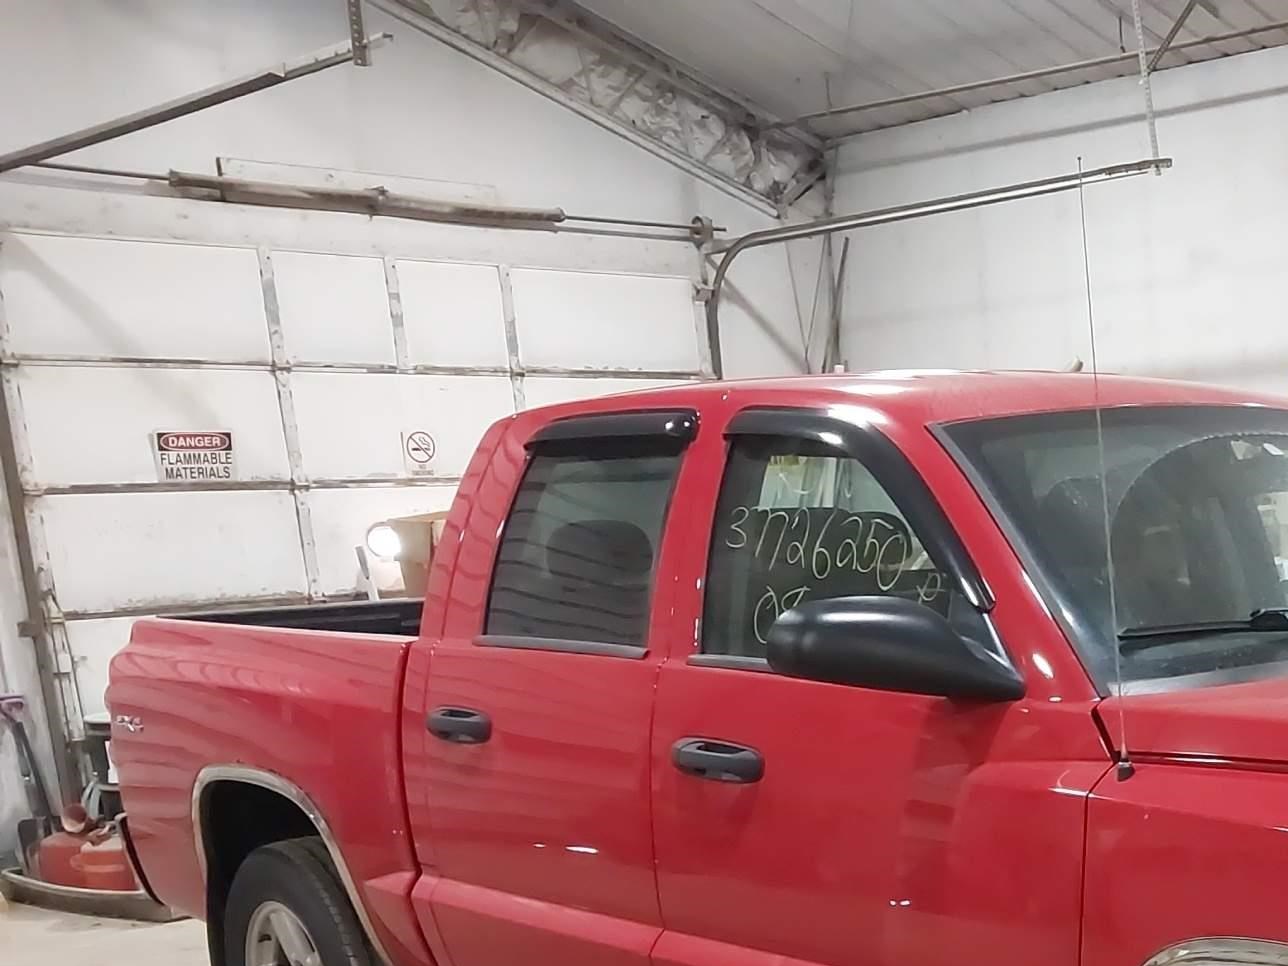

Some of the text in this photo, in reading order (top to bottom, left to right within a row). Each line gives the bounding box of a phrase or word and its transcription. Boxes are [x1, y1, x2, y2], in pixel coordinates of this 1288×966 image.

[167, 436, 221, 448] DANGER
[160, 452, 232, 465] FLAMMABLE
[165, 466, 231, 479] MATERIALS
